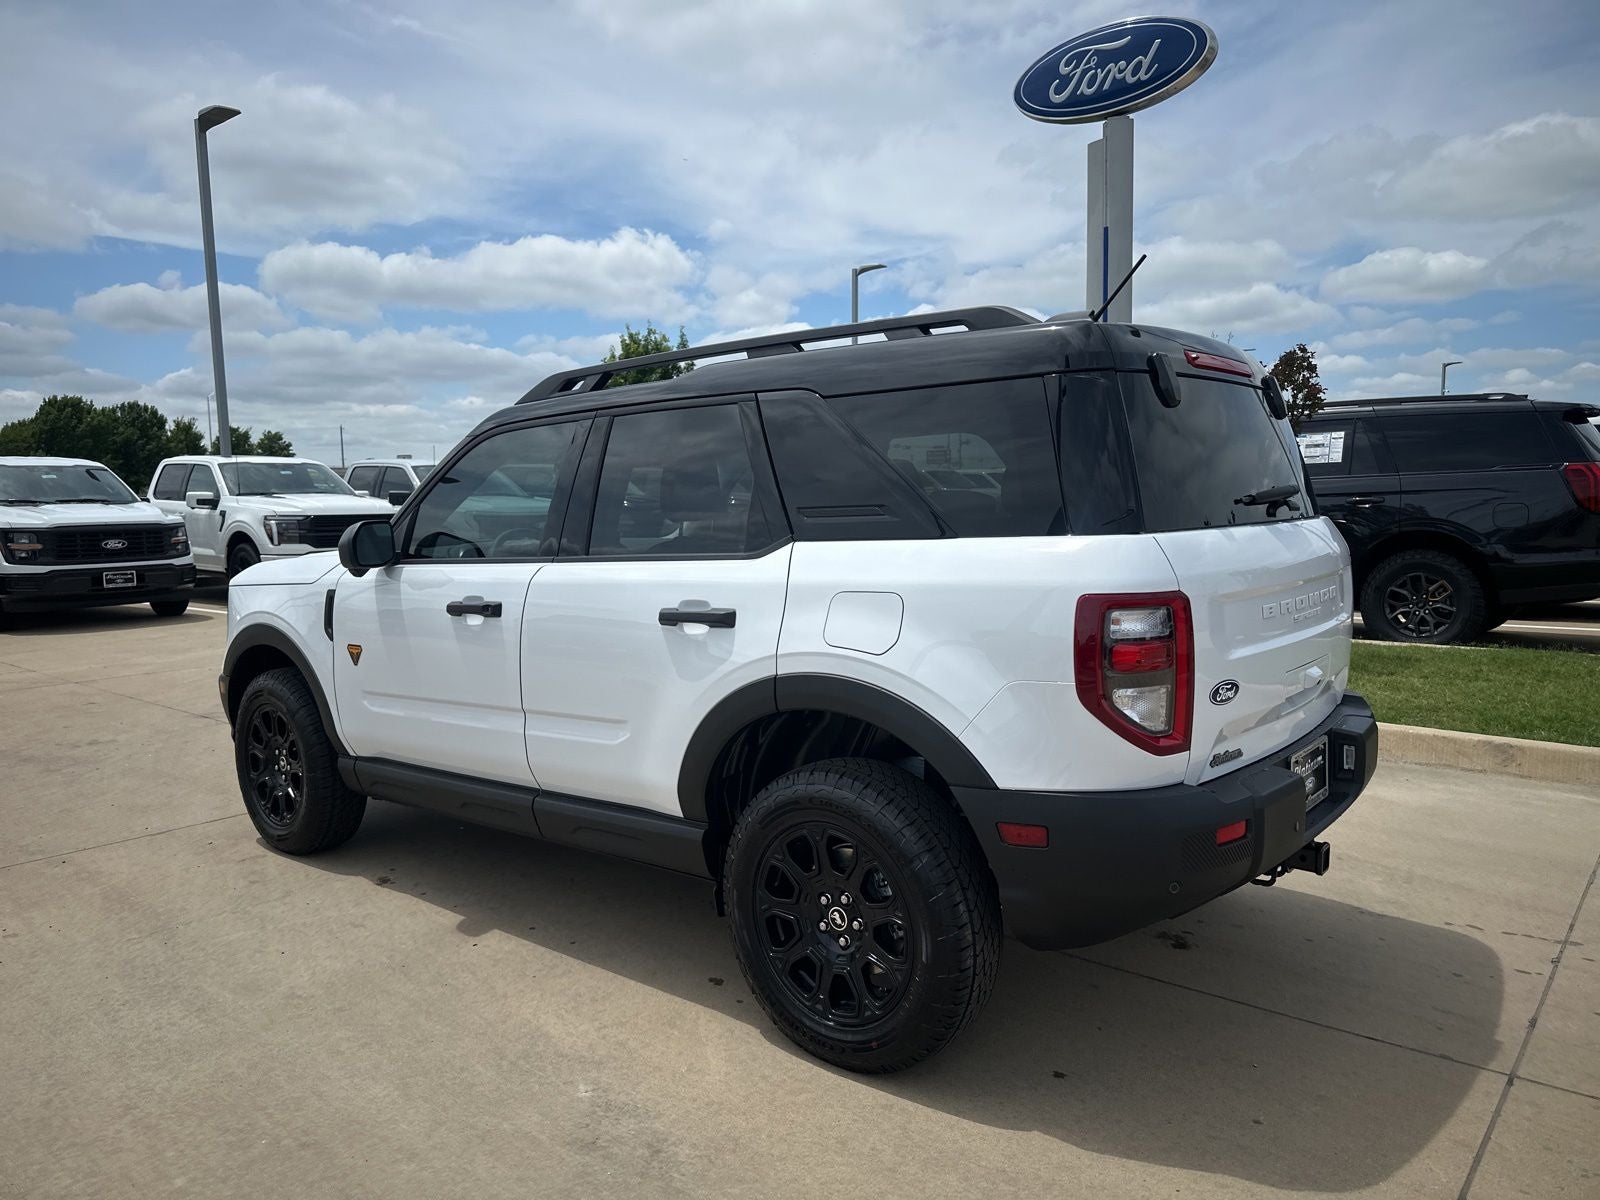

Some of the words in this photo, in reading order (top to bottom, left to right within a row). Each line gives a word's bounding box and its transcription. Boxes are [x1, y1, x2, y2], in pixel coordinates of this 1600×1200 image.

[1049, 36, 1161, 103] Ford
[1262, 586, 1336, 619] BRONCO
[1216, 684, 1236, 701] Ford
